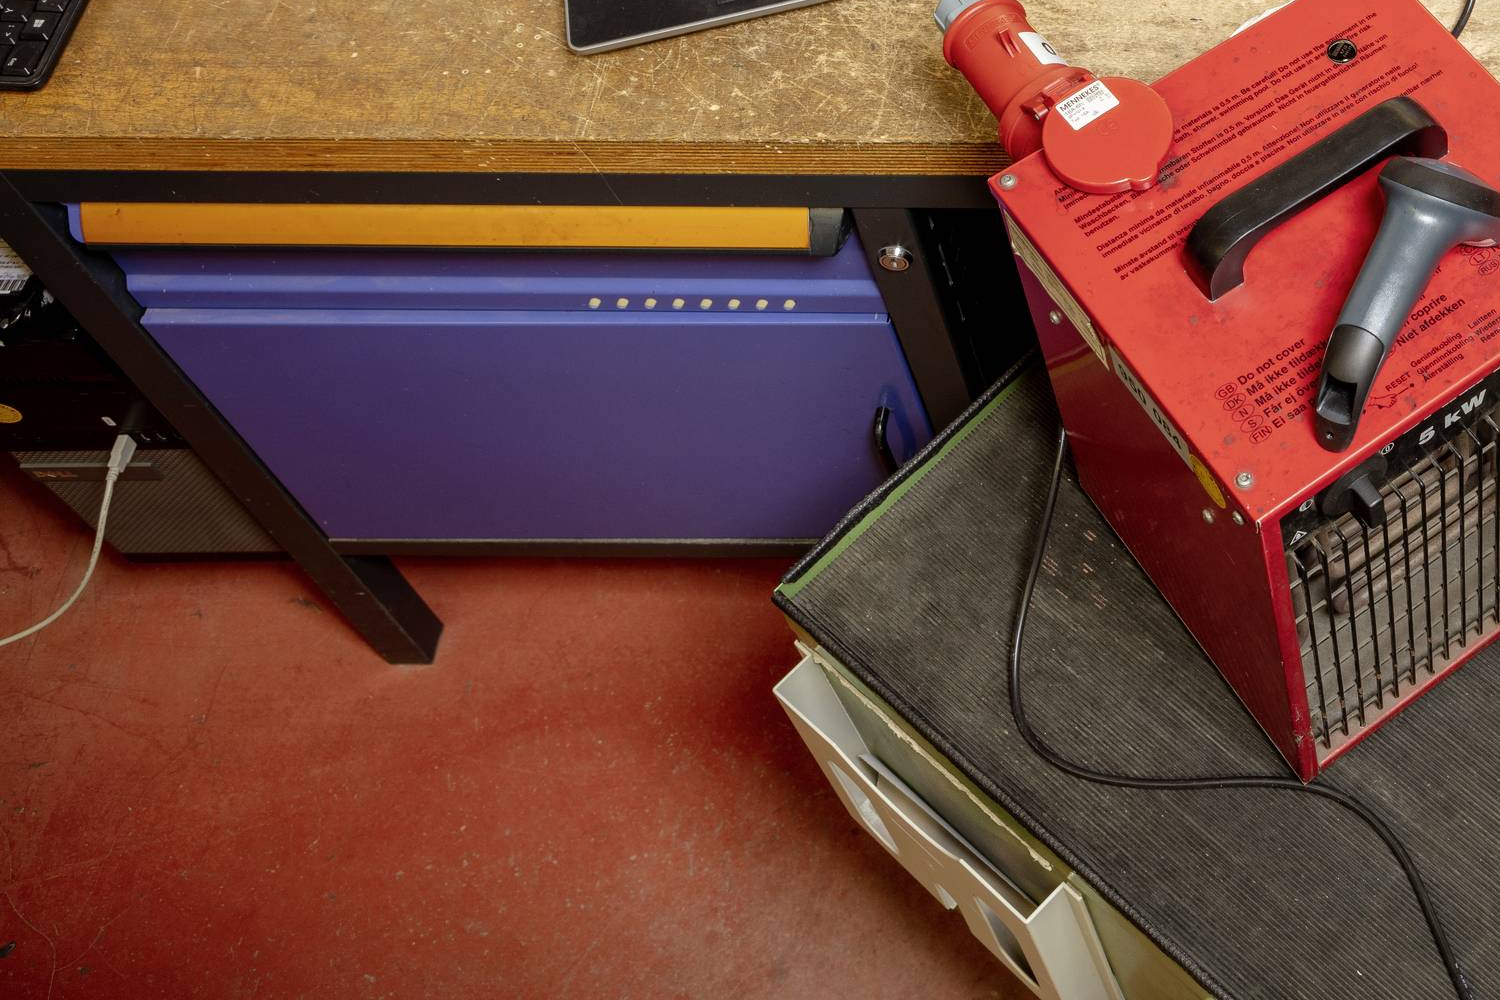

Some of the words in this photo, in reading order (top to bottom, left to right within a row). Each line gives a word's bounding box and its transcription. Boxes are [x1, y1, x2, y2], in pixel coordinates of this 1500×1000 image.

[1277, 97, 1297, 111] Nicht
[1303, 58, 1361, 95] feuergefährlichen
[1359, 43, 1387, 62] Räumen
[1059, 83, 1100, 112] MENNEKES
[1173, 131, 1193, 144] bath,
[1192, 115, 1219, 133] shower,
[1218, 94, 1254, 117] swimming
[1253, 84, 1271, 97] pool.
[1270, 77, 1281, 86] Do
[1280, 69, 1294, 80] not
[1293, 62, 1306, 72] use
[1096, 230, 1129, 252] Distanza
[1127, 214, 1155, 233] minima
[1154, 208, 1165, 217] da
[1164, 188, 1197, 211] materiale
[1196, 162, 1241, 191] infiammabile
[1240, 154, 1252, 164] 0,5
[1251, 149, 1262, 157] m.
[1261, 125, 1300, 151] Attenzione!
[1101, 233, 1140, 259] immediate
[1138, 213, 1173, 236] vicinanze
[1172, 207, 1182, 215] di
[1180, 192, 1208, 211] lavabo,
[1206, 178, 1232, 195] bagno,
[1231, 163, 1255, 180] doccia
[1259, 144, 1286, 163] piscina.
[1084, 214, 1120, 237] benutzen.
[1479, 259, 1498, 274] RUS
[1407, 293, 1448, 322] coprire
[1393, 328, 1419, 347] Niet
[1418, 298, 1466, 332] afdekken
[1237, 371, 1255, 385] Do
[1255, 357, 1276, 374] not
[1274, 337, 1306, 362] cover
[1409, 332, 1463, 368] Genindkobling
[1216, 383, 1236, 398] GB
[1245, 380, 1265, 396] Må
[1264, 365, 1289, 384] ikke
[1253, 391, 1274, 407] Må
[1272, 376, 1297, 395] ikke
[1384, 371, 1412, 392] RESET
[1225, 395, 1243, 409] DK
[1238, 407, 1249, 417] N
[1262, 400, 1283, 418] Får
[1283, 392, 1297, 405] ej
[1271, 415, 1286, 429] Ei
[1285, 402, 1308, 420] saa
[1247, 419, 1257, 428] S
[1418, 426, 1436, 445] 5
[1444, 389, 1487, 429] kW
[1251, 426, 1271, 442] FIN
